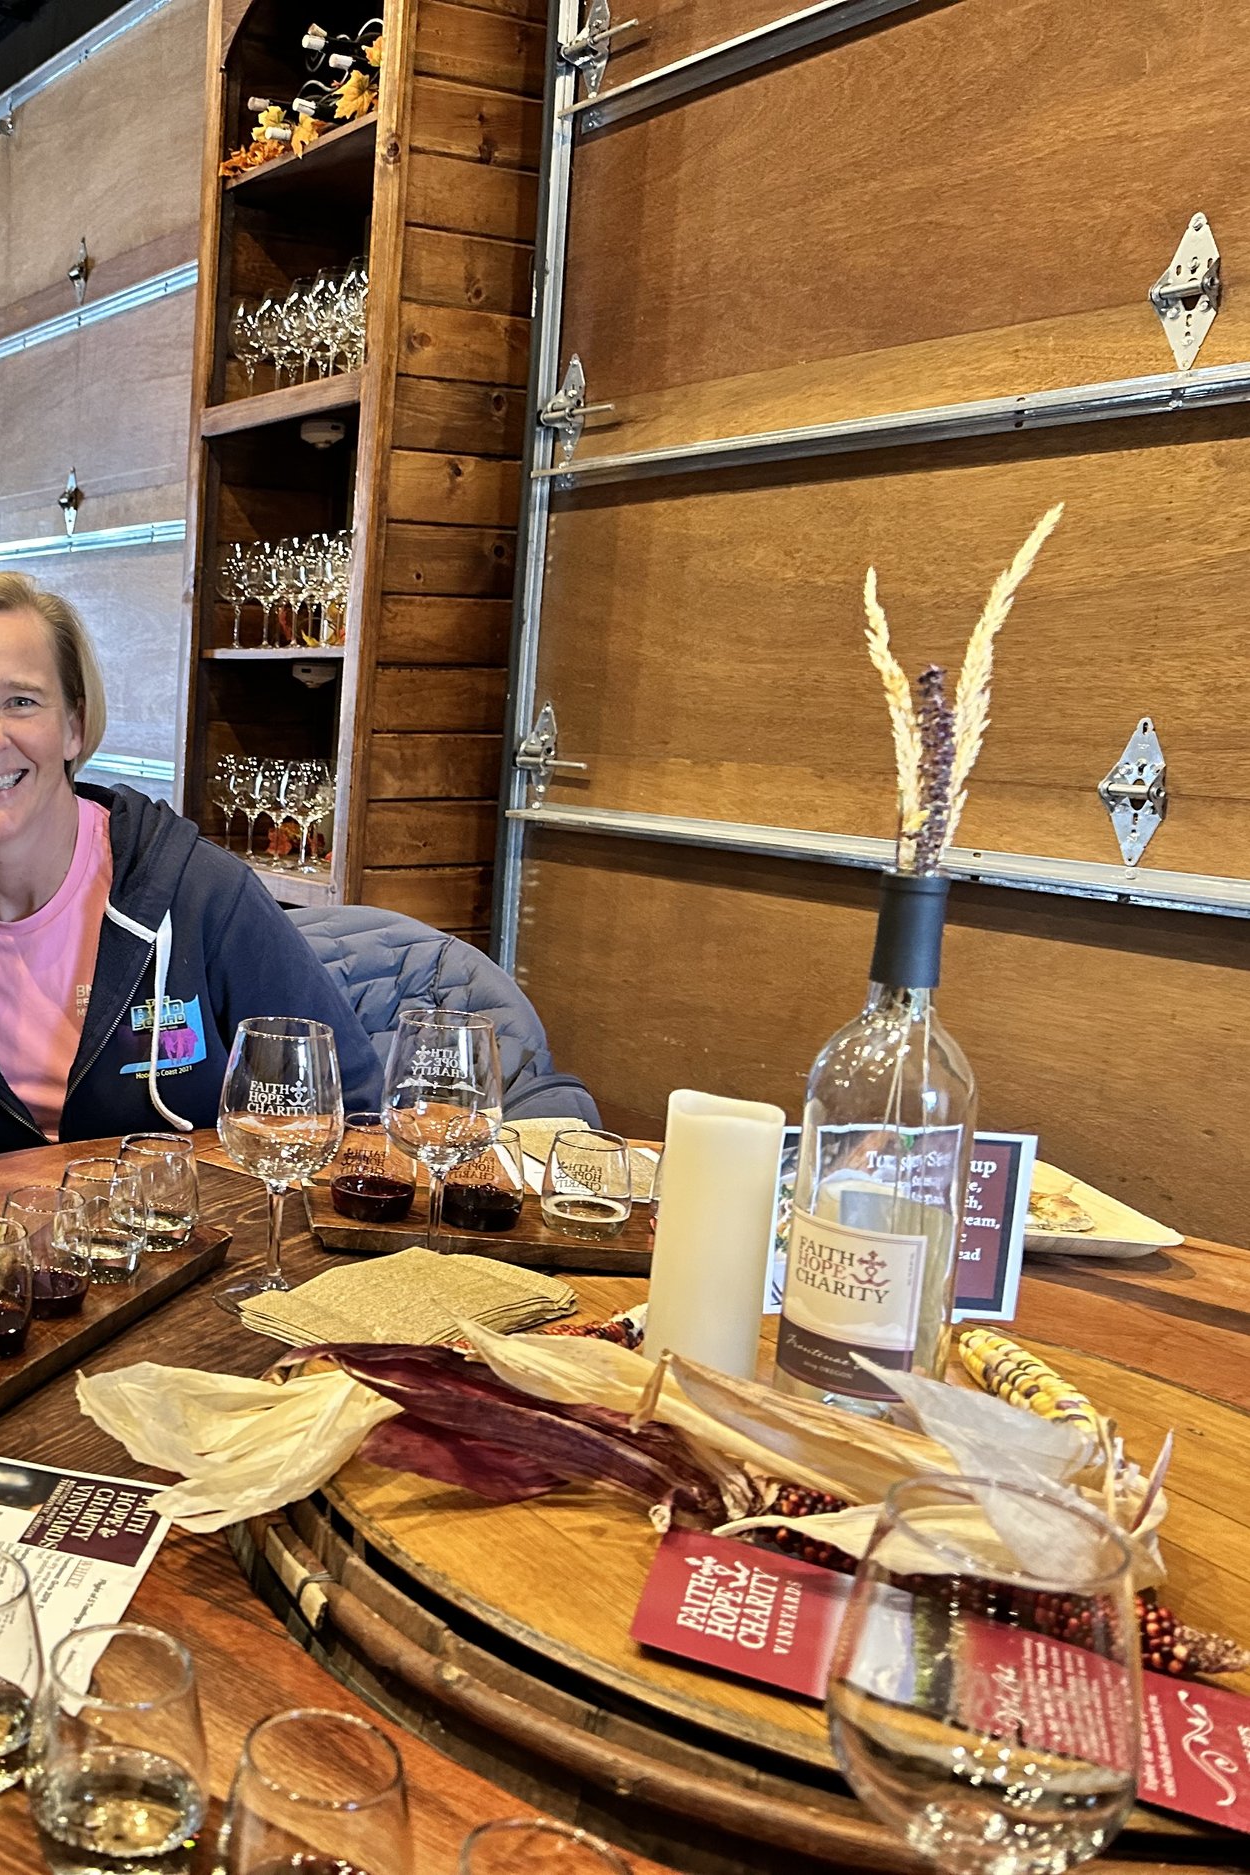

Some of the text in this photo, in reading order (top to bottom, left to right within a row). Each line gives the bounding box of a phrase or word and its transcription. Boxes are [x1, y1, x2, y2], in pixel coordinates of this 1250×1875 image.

[178, 1065, 193, 1075] 2021
[250, 1080, 290, 1095] FAITH
[247, 1103, 311, 1117] CHARITY
[249, 1091, 285, 1106] HOPE
[798, 1251, 847, 1280] HOPE
[799, 1236, 855, 1267] FAITH
[796, 1267, 889, 1303] CHARITY
[37, 1485, 96, 1549] VINEYARDS
[71, 1488, 116, 1541] CHARITY
[98, 1491, 138, 1538] HOPE &
[64, 1559, 94, 1589] WHITE
[677, 1573, 718, 1632] FAITH
[705, 1586, 744, 1642] HOPE
[737, 1567, 779, 1650] CHARITY
[773, 1580, 803, 1655] VINEYARDS
